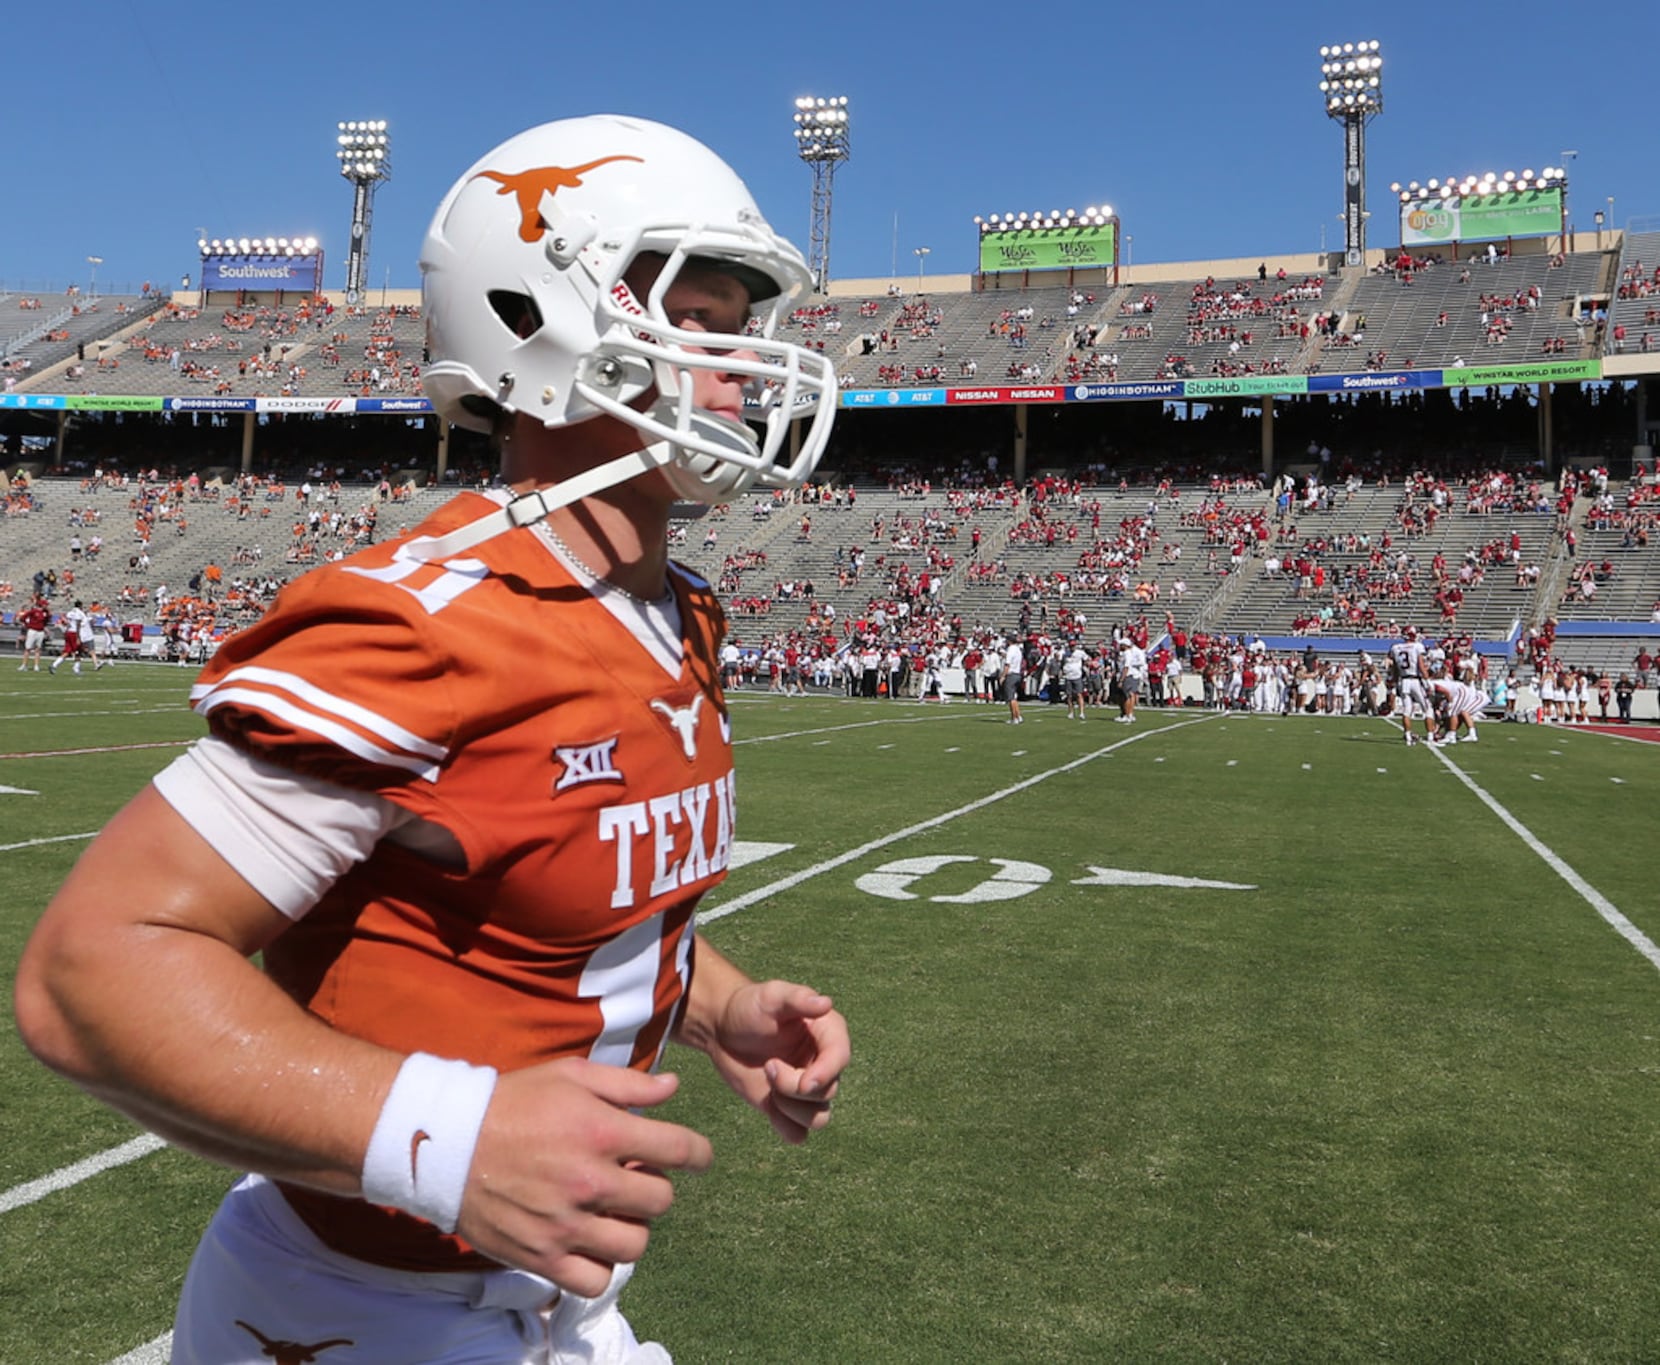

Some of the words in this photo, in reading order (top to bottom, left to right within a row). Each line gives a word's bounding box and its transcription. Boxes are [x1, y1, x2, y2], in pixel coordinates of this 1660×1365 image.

[219, 265, 289, 278] Southwest
[1473, 370, 1514, 380] WINSTAR
[1515, 369, 1549, 378] WORLD
[1551, 366, 1588, 375] RESORT
[1343, 376, 1399, 387] Southwest
[1089, 385, 1171, 396] HIGGINBOTHAM
[1187, 382, 1240, 394] StubHub
[855, 394, 875, 403] AT&T
[912, 392, 933, 402] AT&T
[955, 391, 998, 400] NISSAN
[1011, 389, 1055, 399] NISSAN
[181, 400, 246, 408] HIGGINBOTHAM
[381, 400, 421, 410] Southwest
[1399, 651, 1410, 669] 3
[555, 737, 624, 791] XII
[599, 768, 737, 910] TEXA
